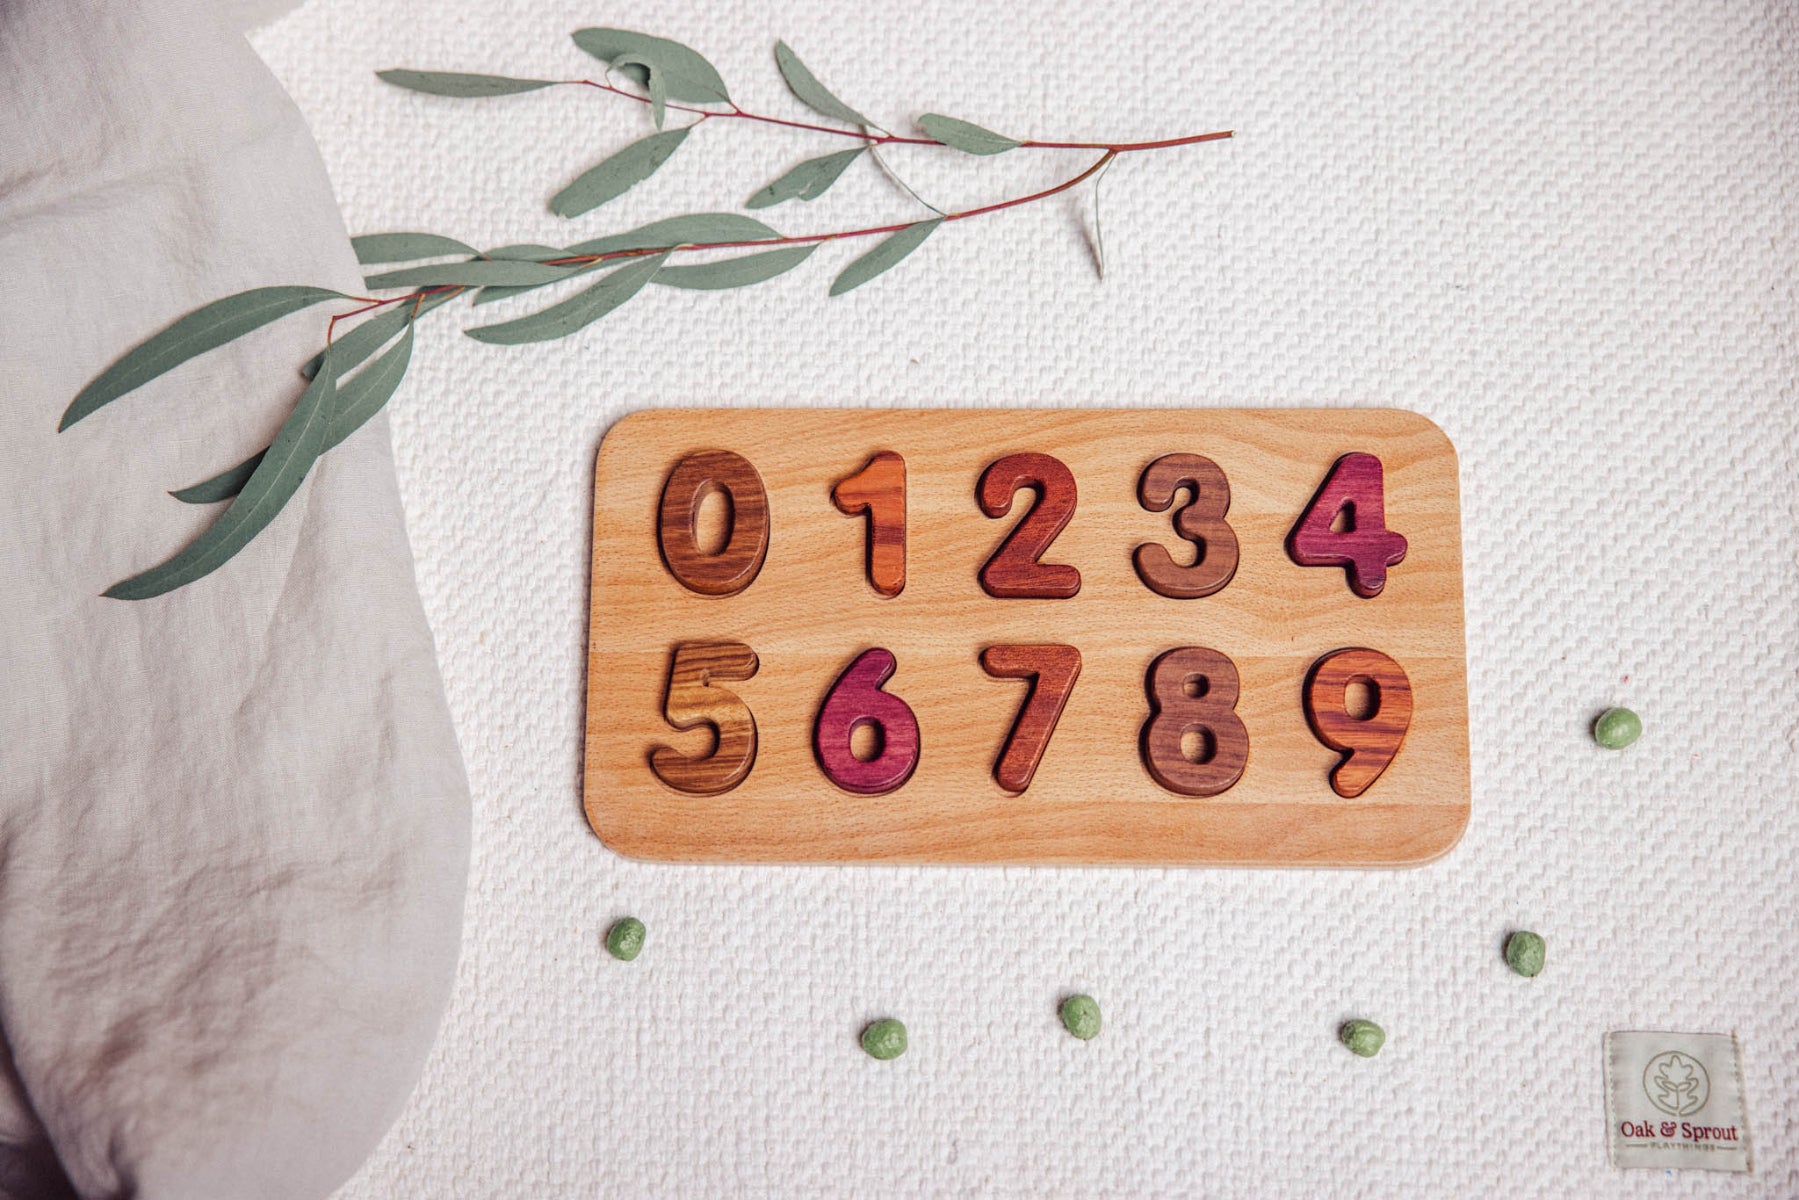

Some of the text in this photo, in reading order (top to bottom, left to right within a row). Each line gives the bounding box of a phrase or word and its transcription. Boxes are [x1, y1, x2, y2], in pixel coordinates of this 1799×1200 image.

[658, 448, 1407, 599] 0 1 2 3 4
[649, 640, 1413, 798] 5 6 7 8 9
[1621, 1120, 1738, 1142] Oak & Sprout
[1650, 1141, 1715, 1152] PLAYTHINGS
